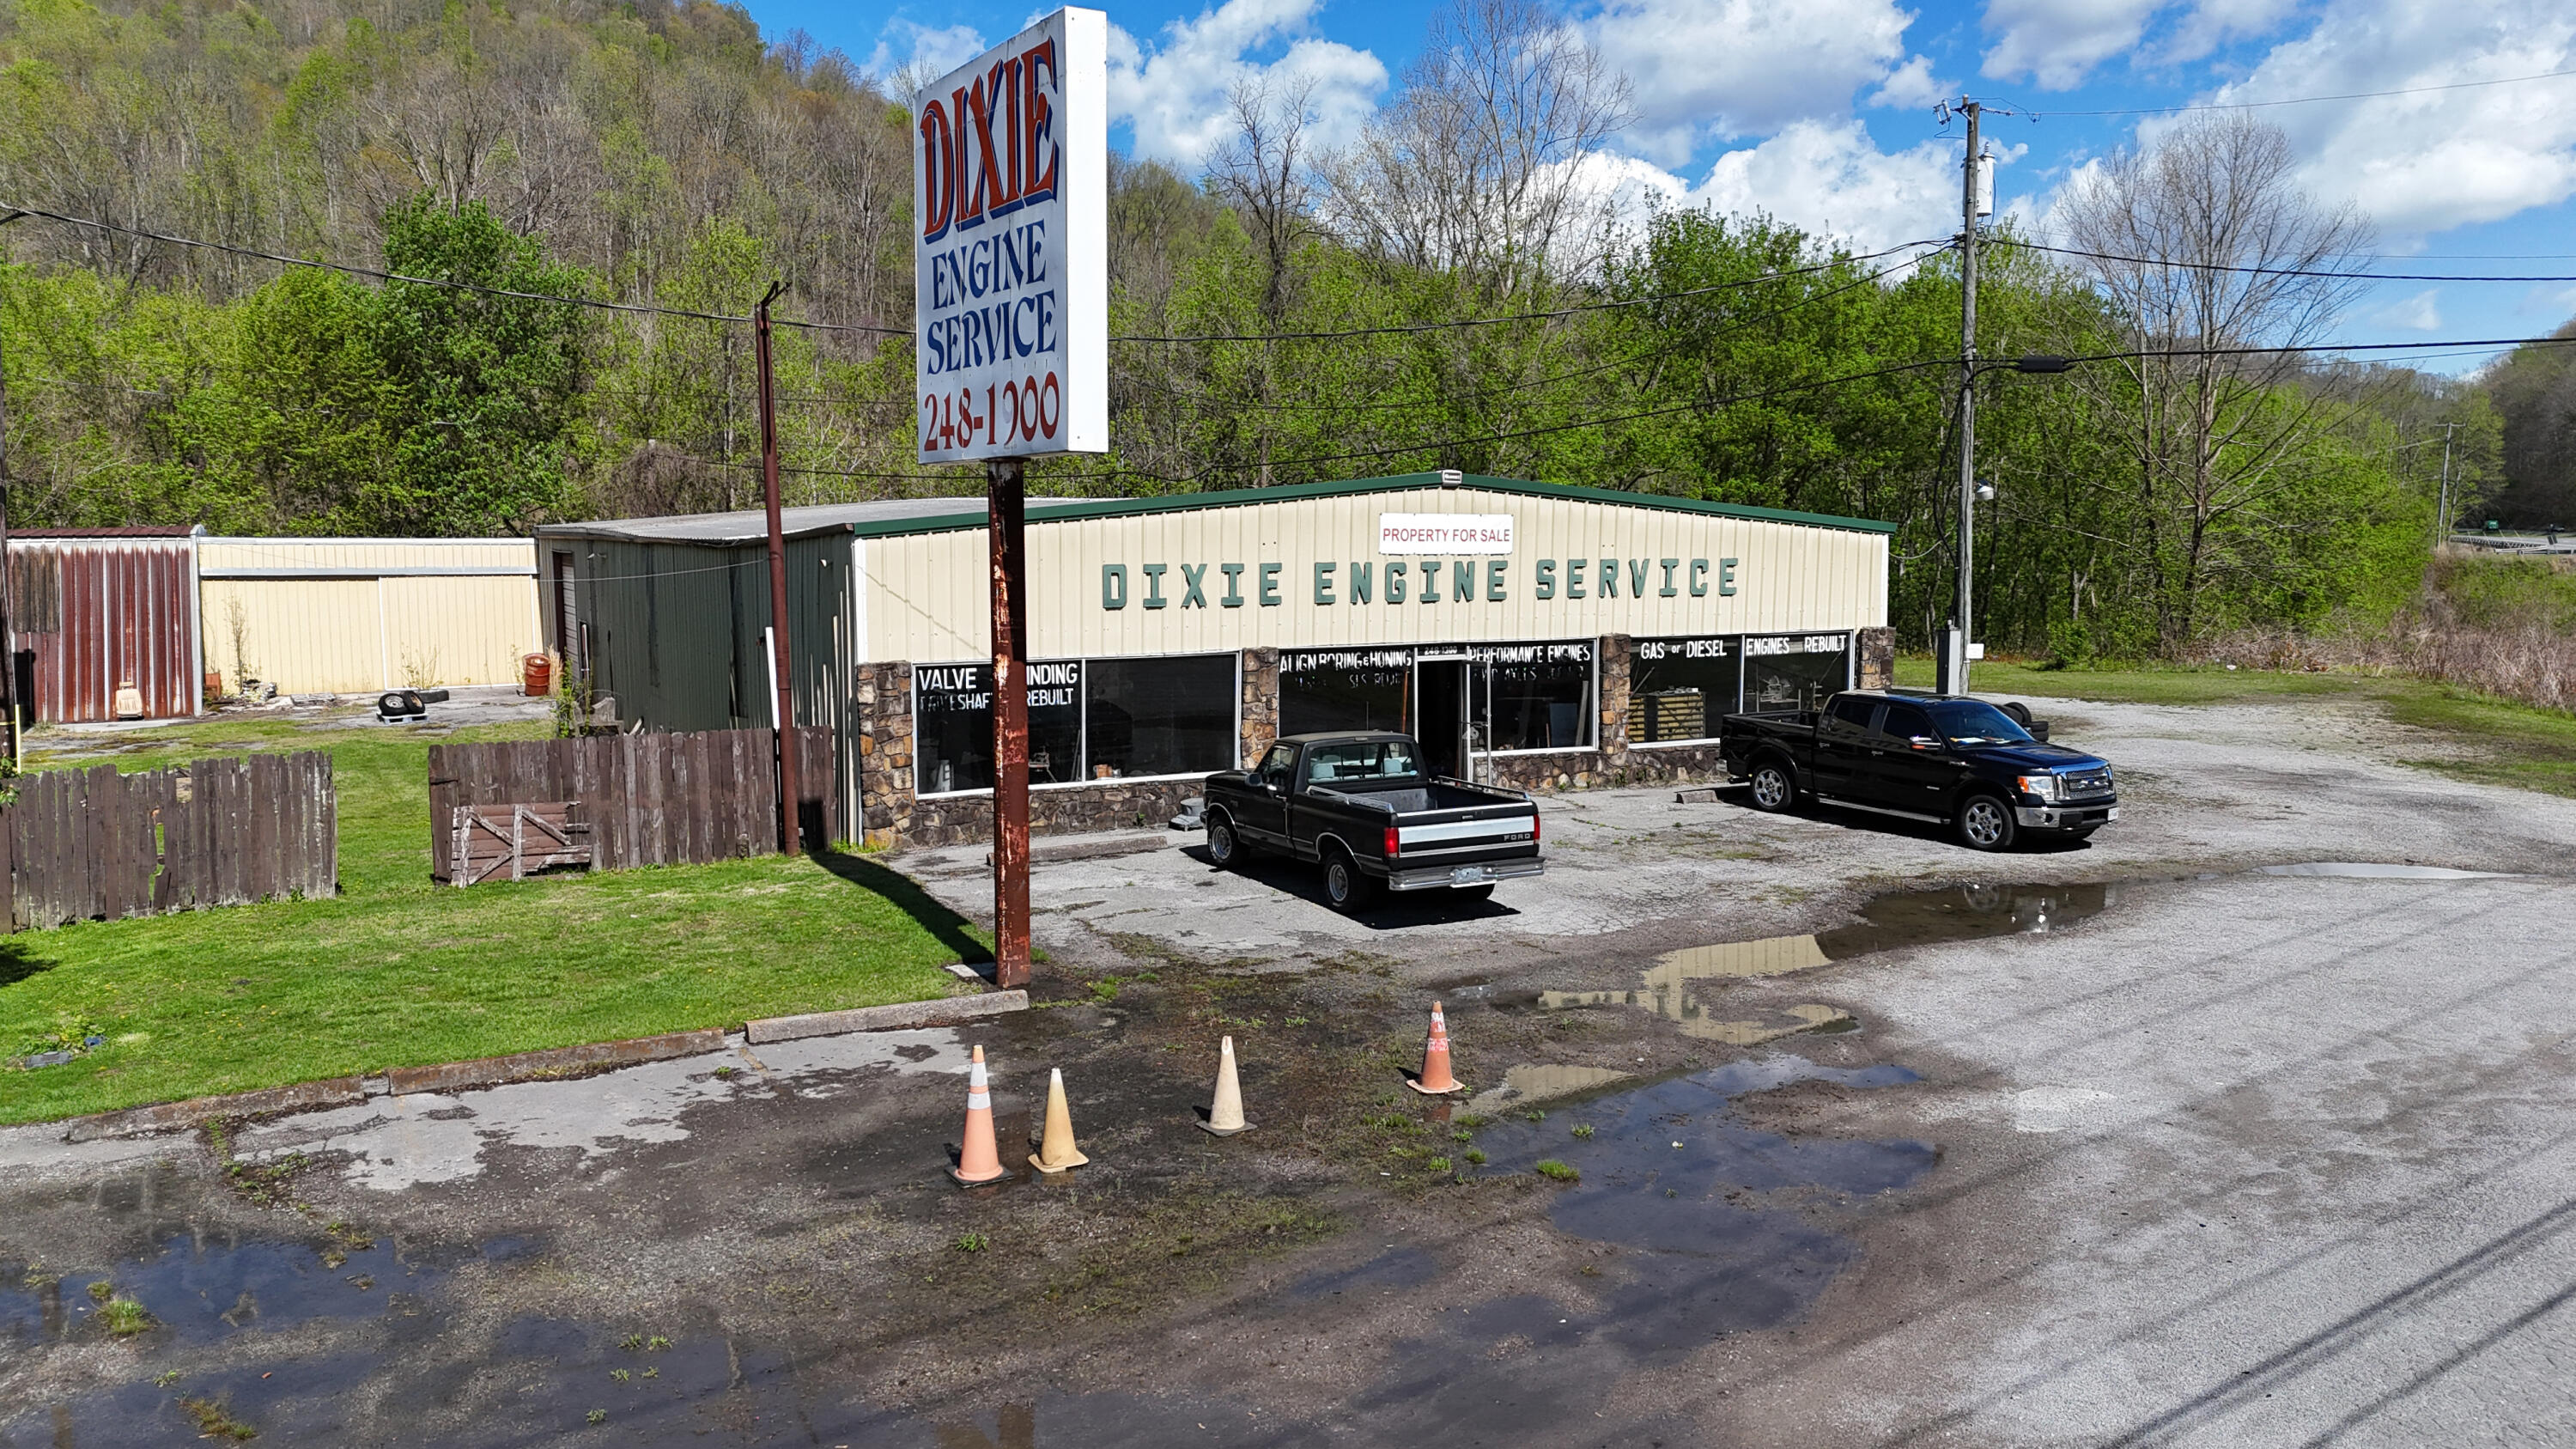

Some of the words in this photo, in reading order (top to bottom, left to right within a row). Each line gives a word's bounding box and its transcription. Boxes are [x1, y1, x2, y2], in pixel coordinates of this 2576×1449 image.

[920, 35, 1060, 245] DIXIE
[932, 220, 1046, 310] ENGINE
[927, 289, 1057, 375] SERVICE
[924, 370, 1060, 452] 248-1900
[1382, 528, 1449, 542] PROPERTY
[1452, 529, 1477, 542] FOR
[1480, 529, 1510, 542] SALE
[1103, 563, 1282, 610] DIXIE
[1315, 560, 1509, 605] ENGINE
[1535, 557, 1739, 600] SERVICE
[1279, 654, 1316, 673] ALIGN
[1370, 649, 1412, 668] HONING
[1470, 646, 1543, 663] PERFORMANCE
[1547, 645, 1590, 662] ENGINES
[1640, 642, 1665, 660] GAS
[1671, 643, 1681, 654] or
[1686, 640, 1727, 658] DIESEL
[1745, 637, 1790, 656] ENGINES
[1804, 635, 1846, 653] REBUILT
[919, 667, 977, 691] VALVE
[1026, 664, 1078, 685] INDING
[1504, 833, 1531, 842] FORD
